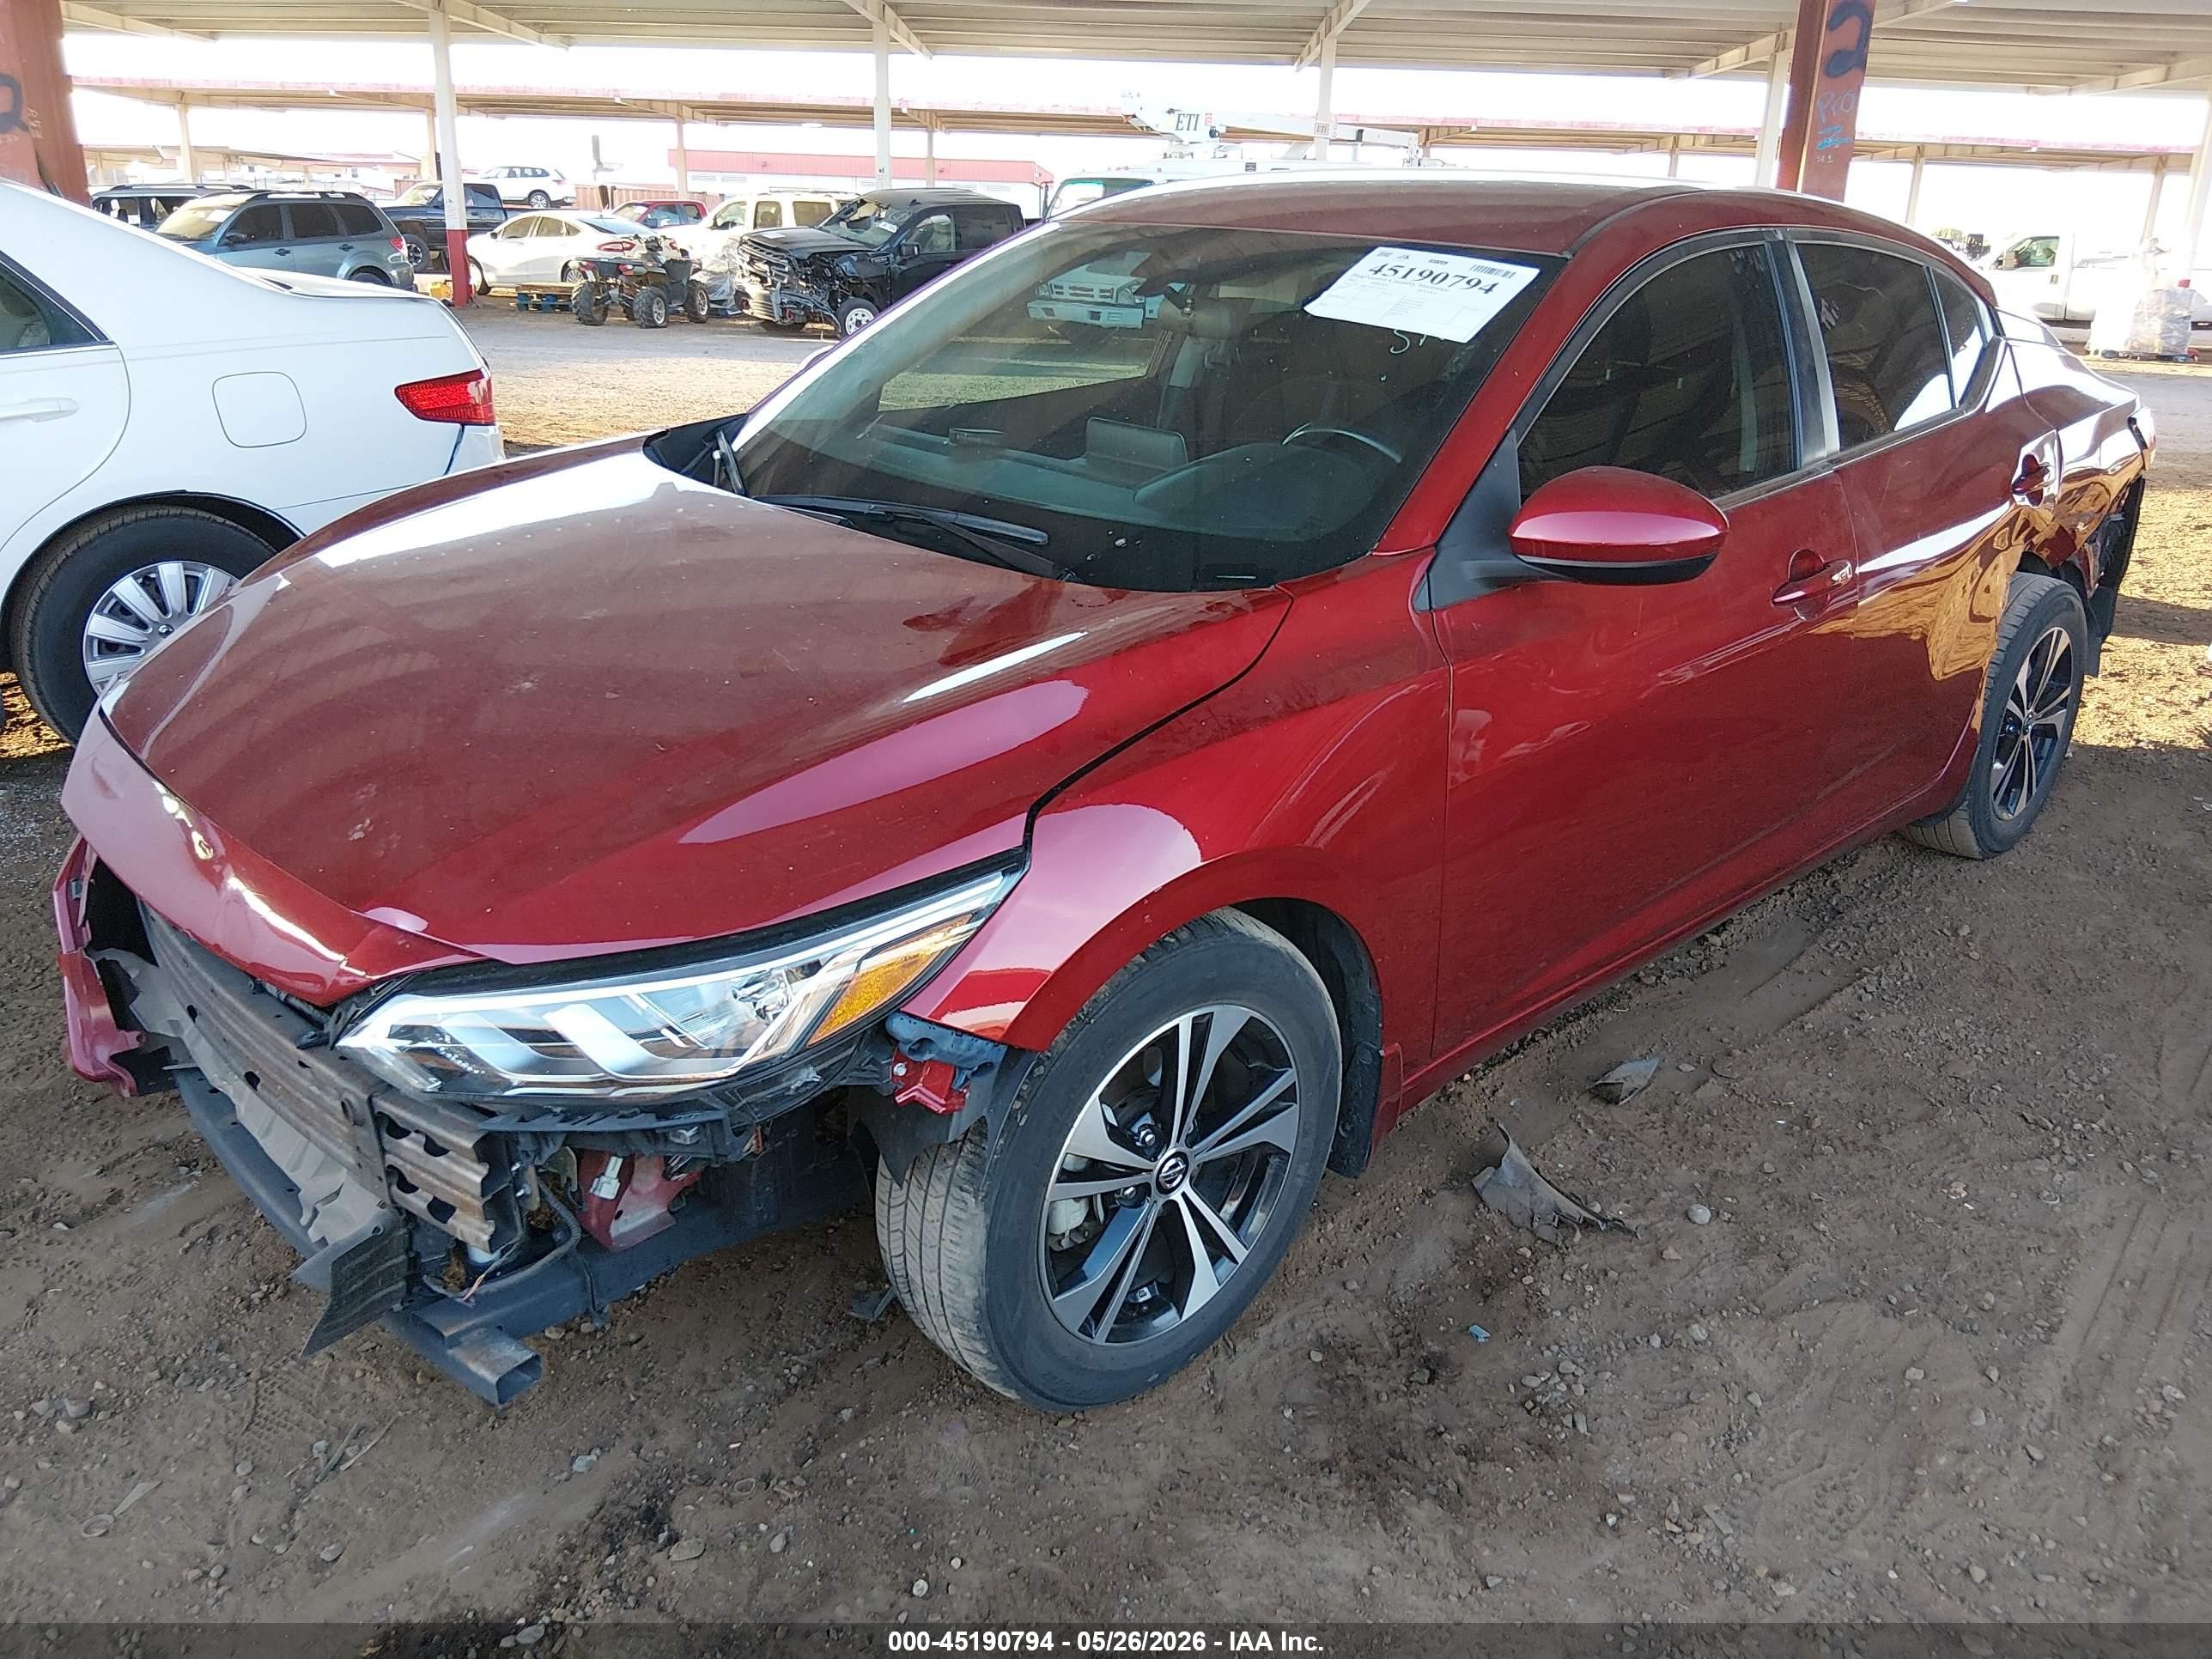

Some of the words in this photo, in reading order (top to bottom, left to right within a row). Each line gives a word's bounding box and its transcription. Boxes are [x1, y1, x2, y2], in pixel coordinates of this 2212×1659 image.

[1826, 1, 1870, 78] 2
[1175, 113, 1200, 131] ETI
[1369, 263, 1499, 294] 45190794
